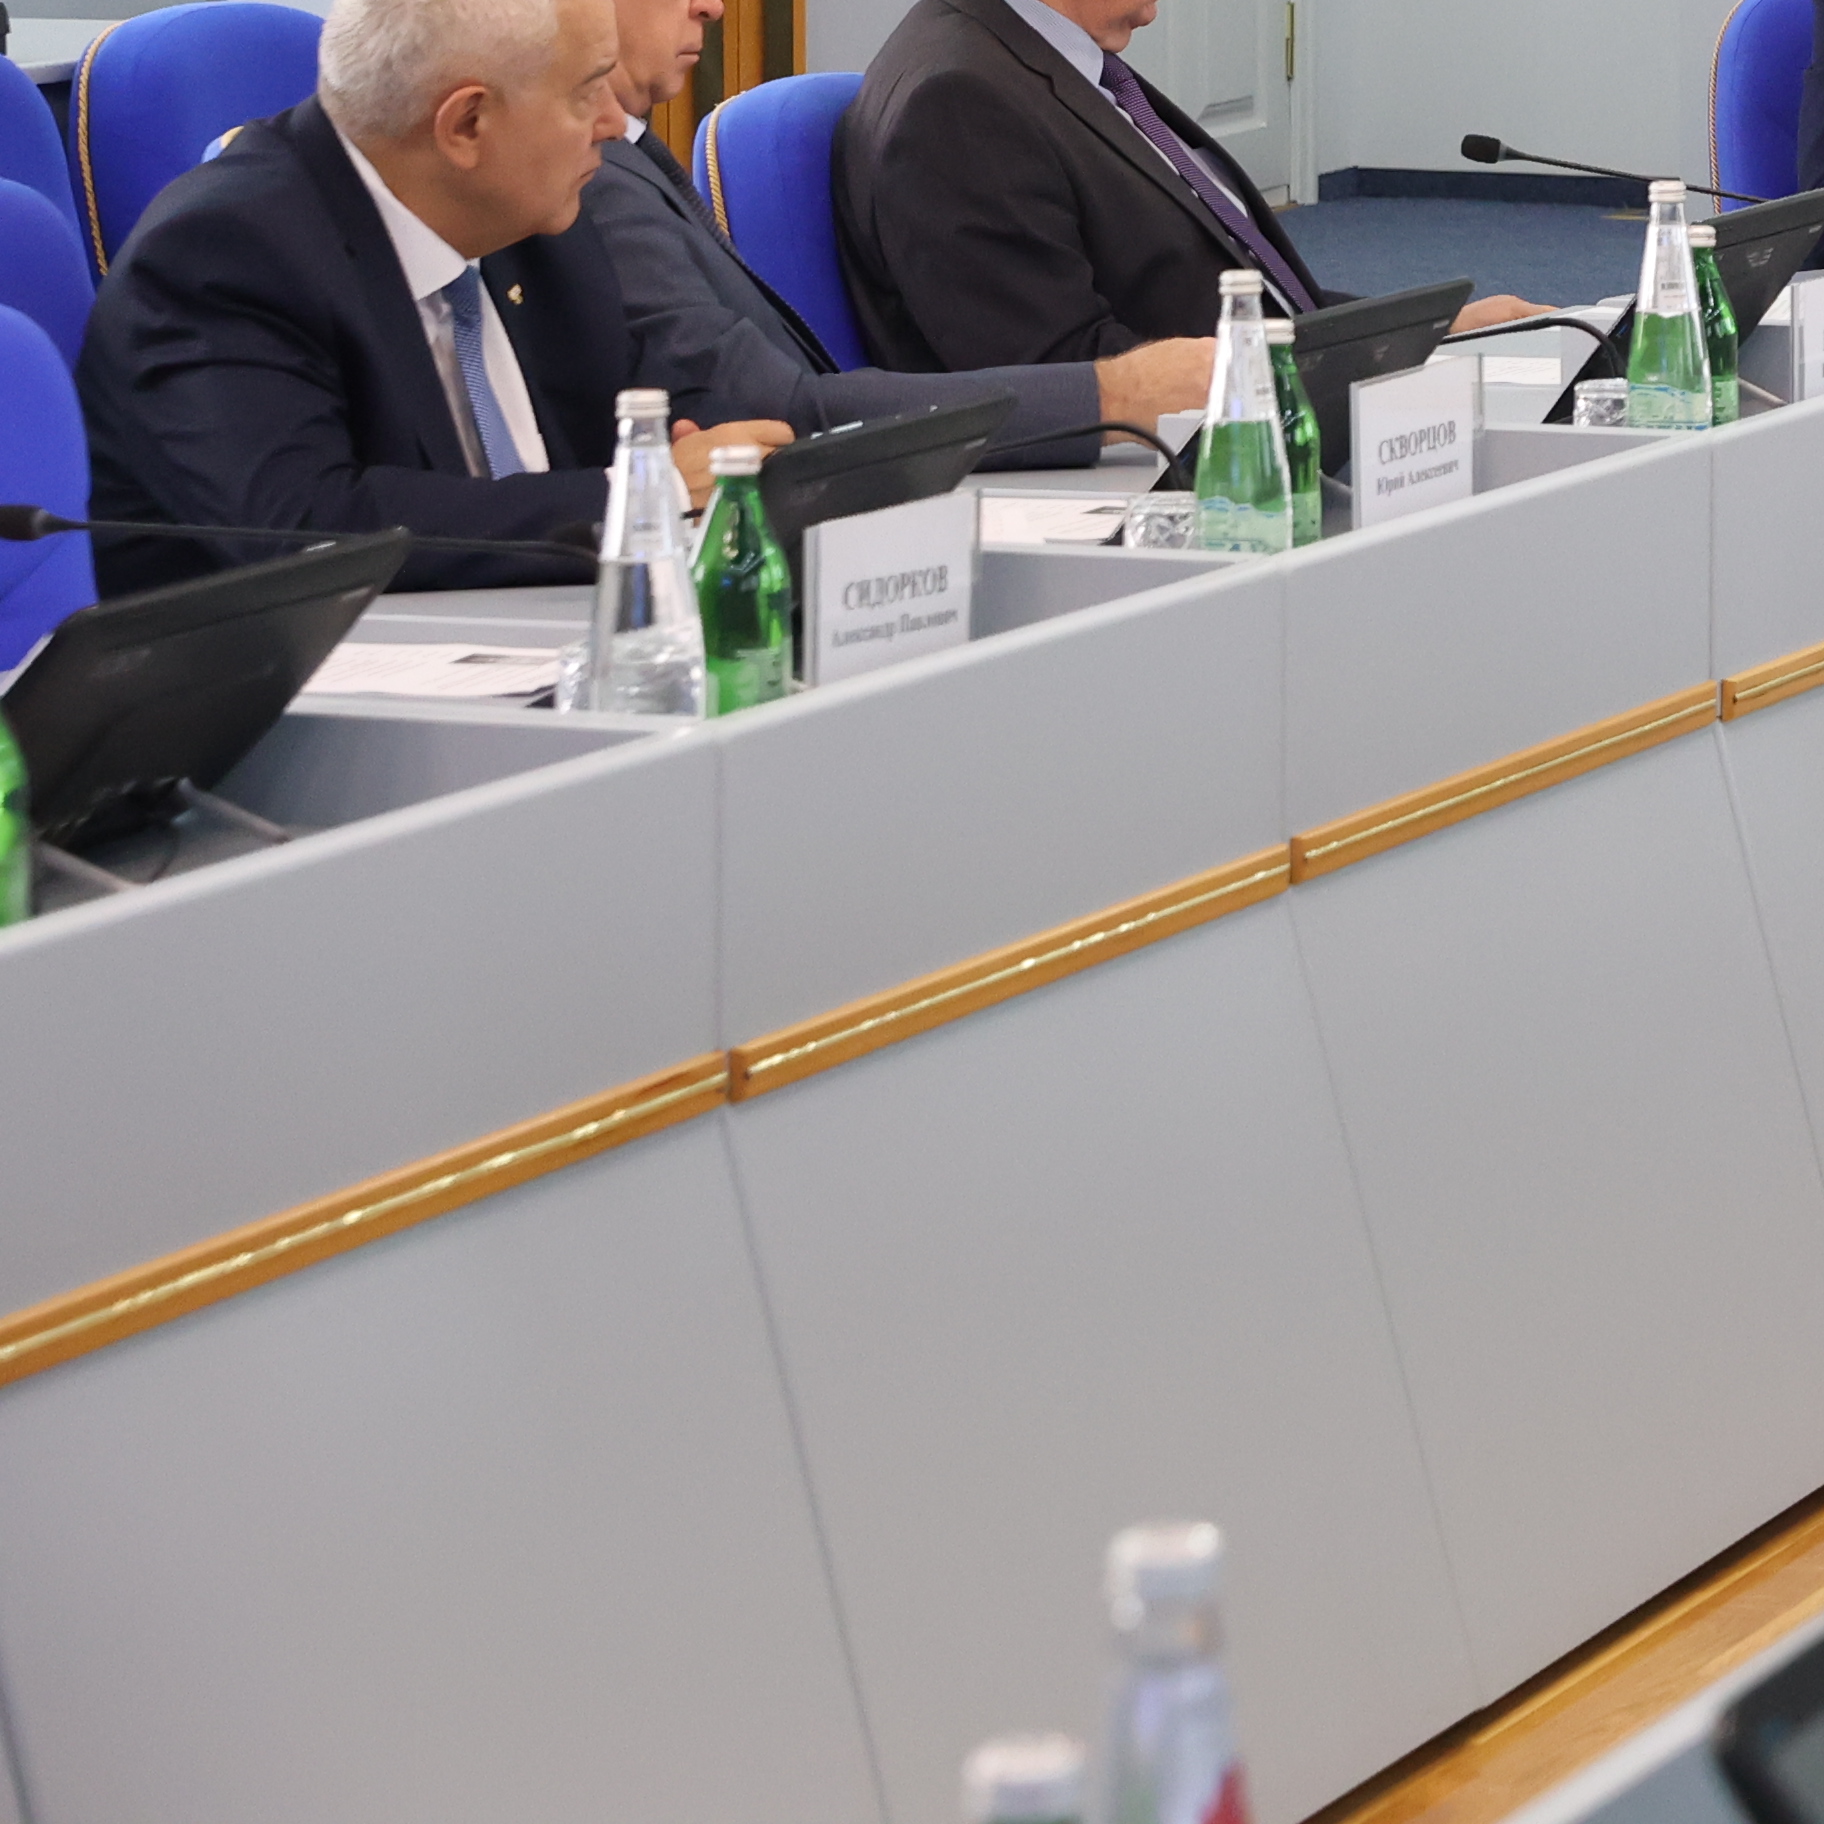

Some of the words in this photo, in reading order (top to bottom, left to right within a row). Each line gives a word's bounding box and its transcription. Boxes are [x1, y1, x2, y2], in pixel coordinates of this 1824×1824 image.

[1378, 420, 1457, 465] СКВОРЦОВ
[1376, 474, 1406, 497] Юрий
[1408, 459, 1460, 485] Алексеевич
[843, 565, 950, 611] СИДОРКОВ
